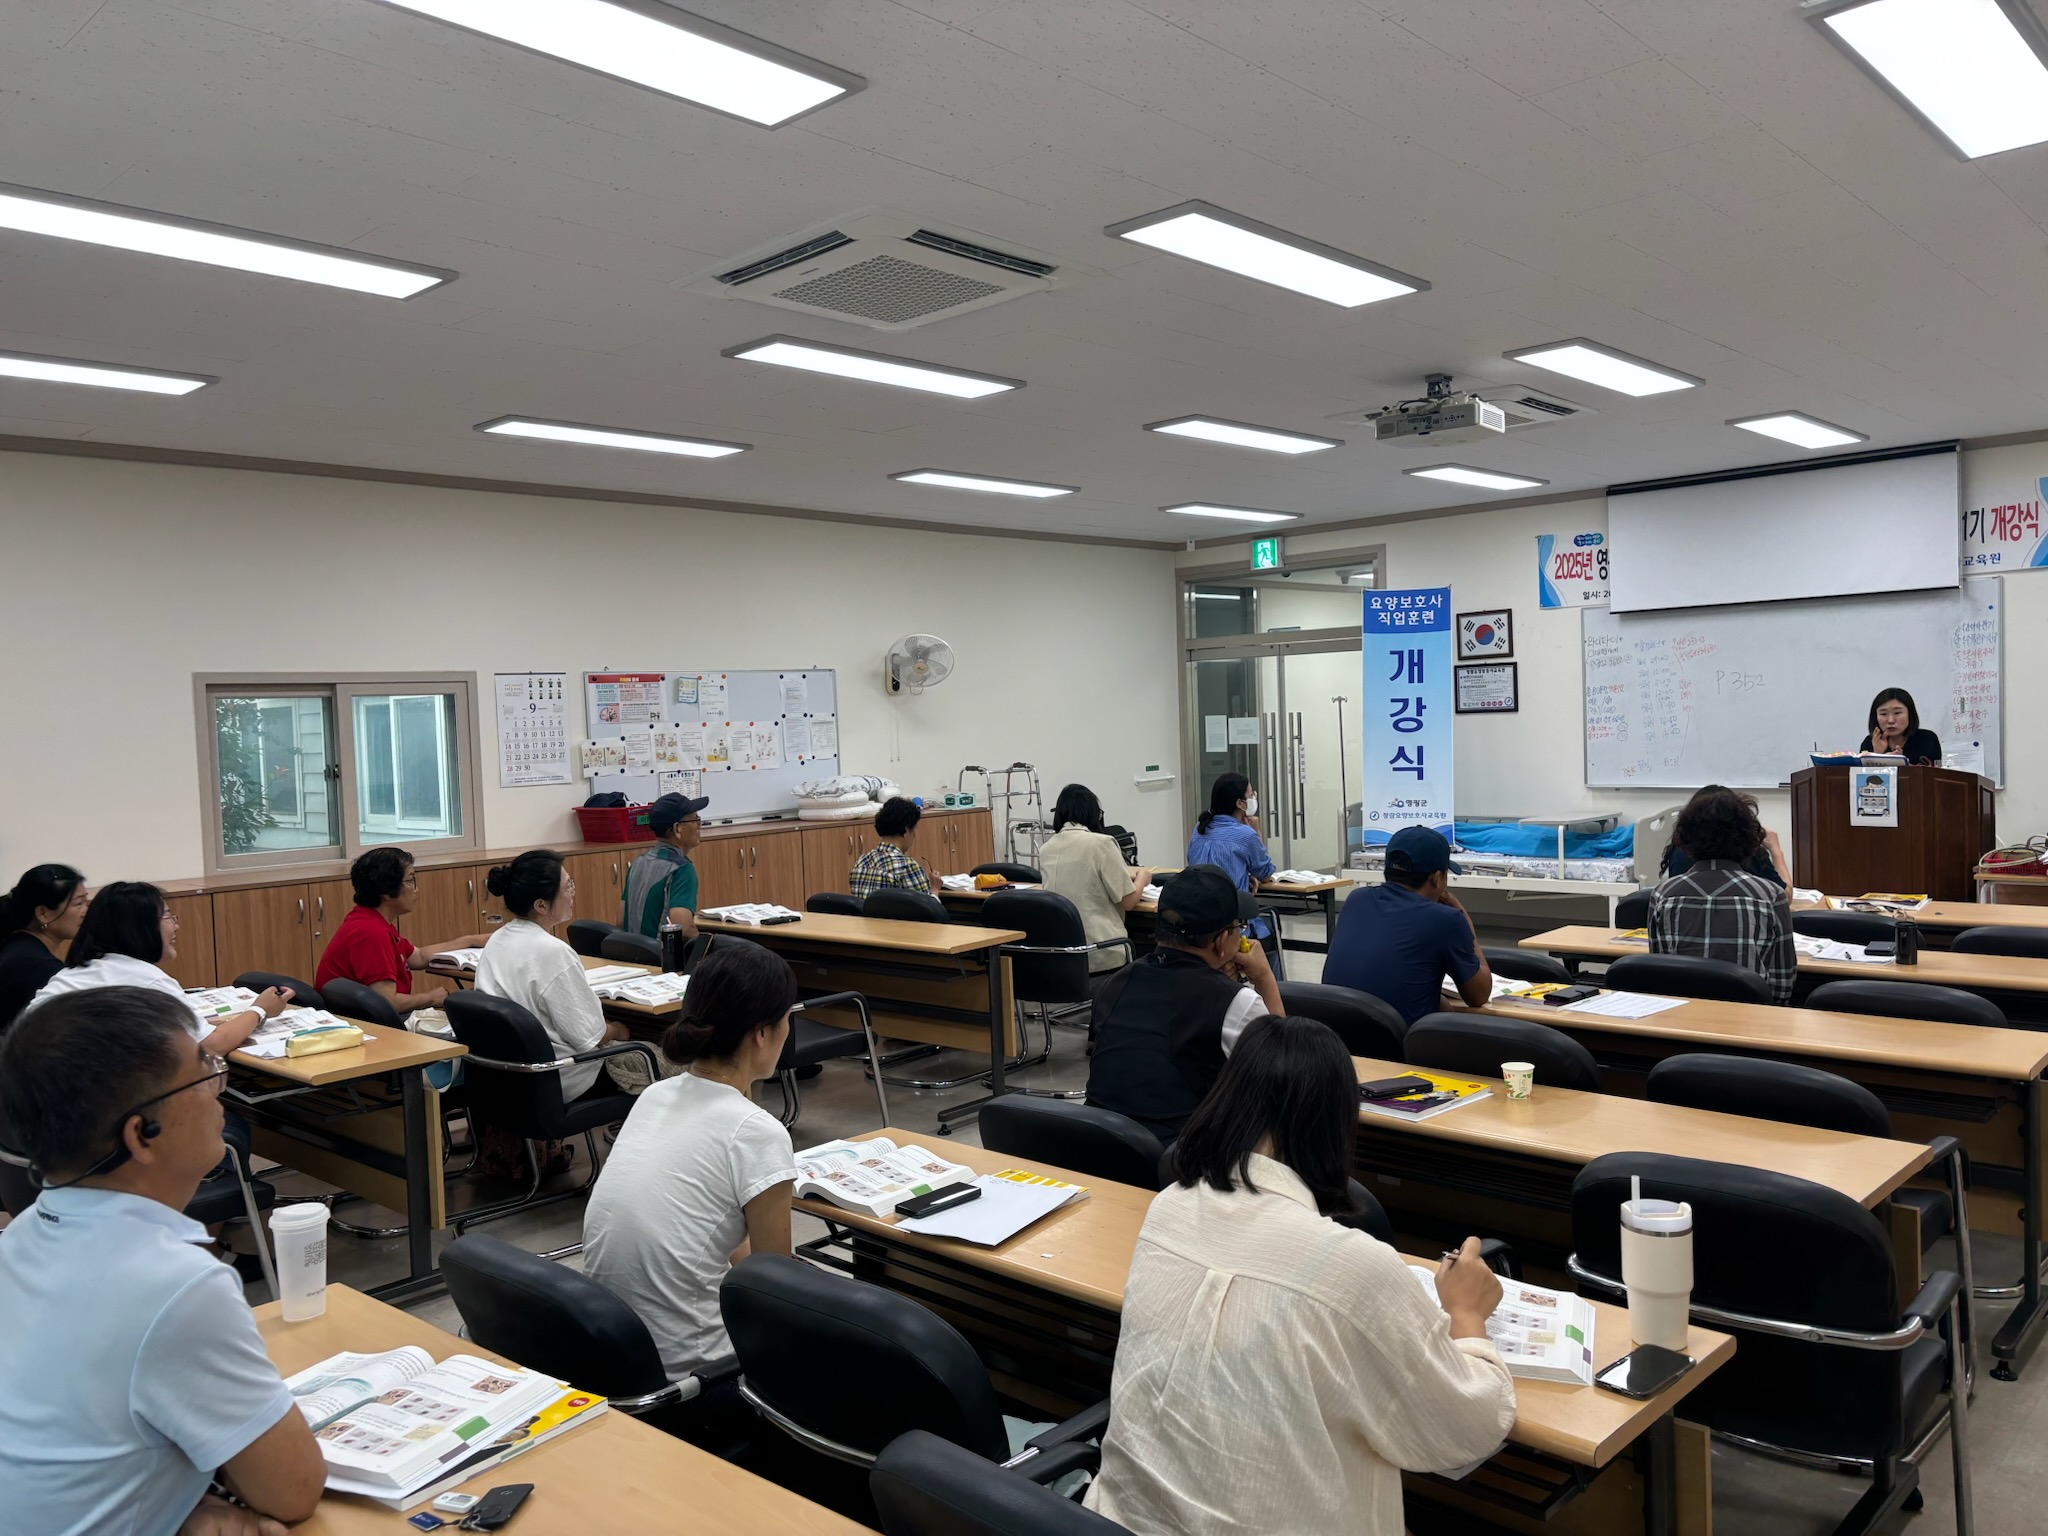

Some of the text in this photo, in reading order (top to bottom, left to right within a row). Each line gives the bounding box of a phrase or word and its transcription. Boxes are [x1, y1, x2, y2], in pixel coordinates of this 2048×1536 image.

[1554, 550, 1593, 580] 2025년
[1990, 501, 2038, 541] 개강식
[1962, 552, 2000, 566] 교육원
[1370, 593, 1443, 610] 요양보호사
[1583, 591, 1601, 600] 일시:
[1378, 610, 1434, 626] 직업훈련
[529, 703, 536, 714] 9
[1389, 649, 1427, 780] 개강식
